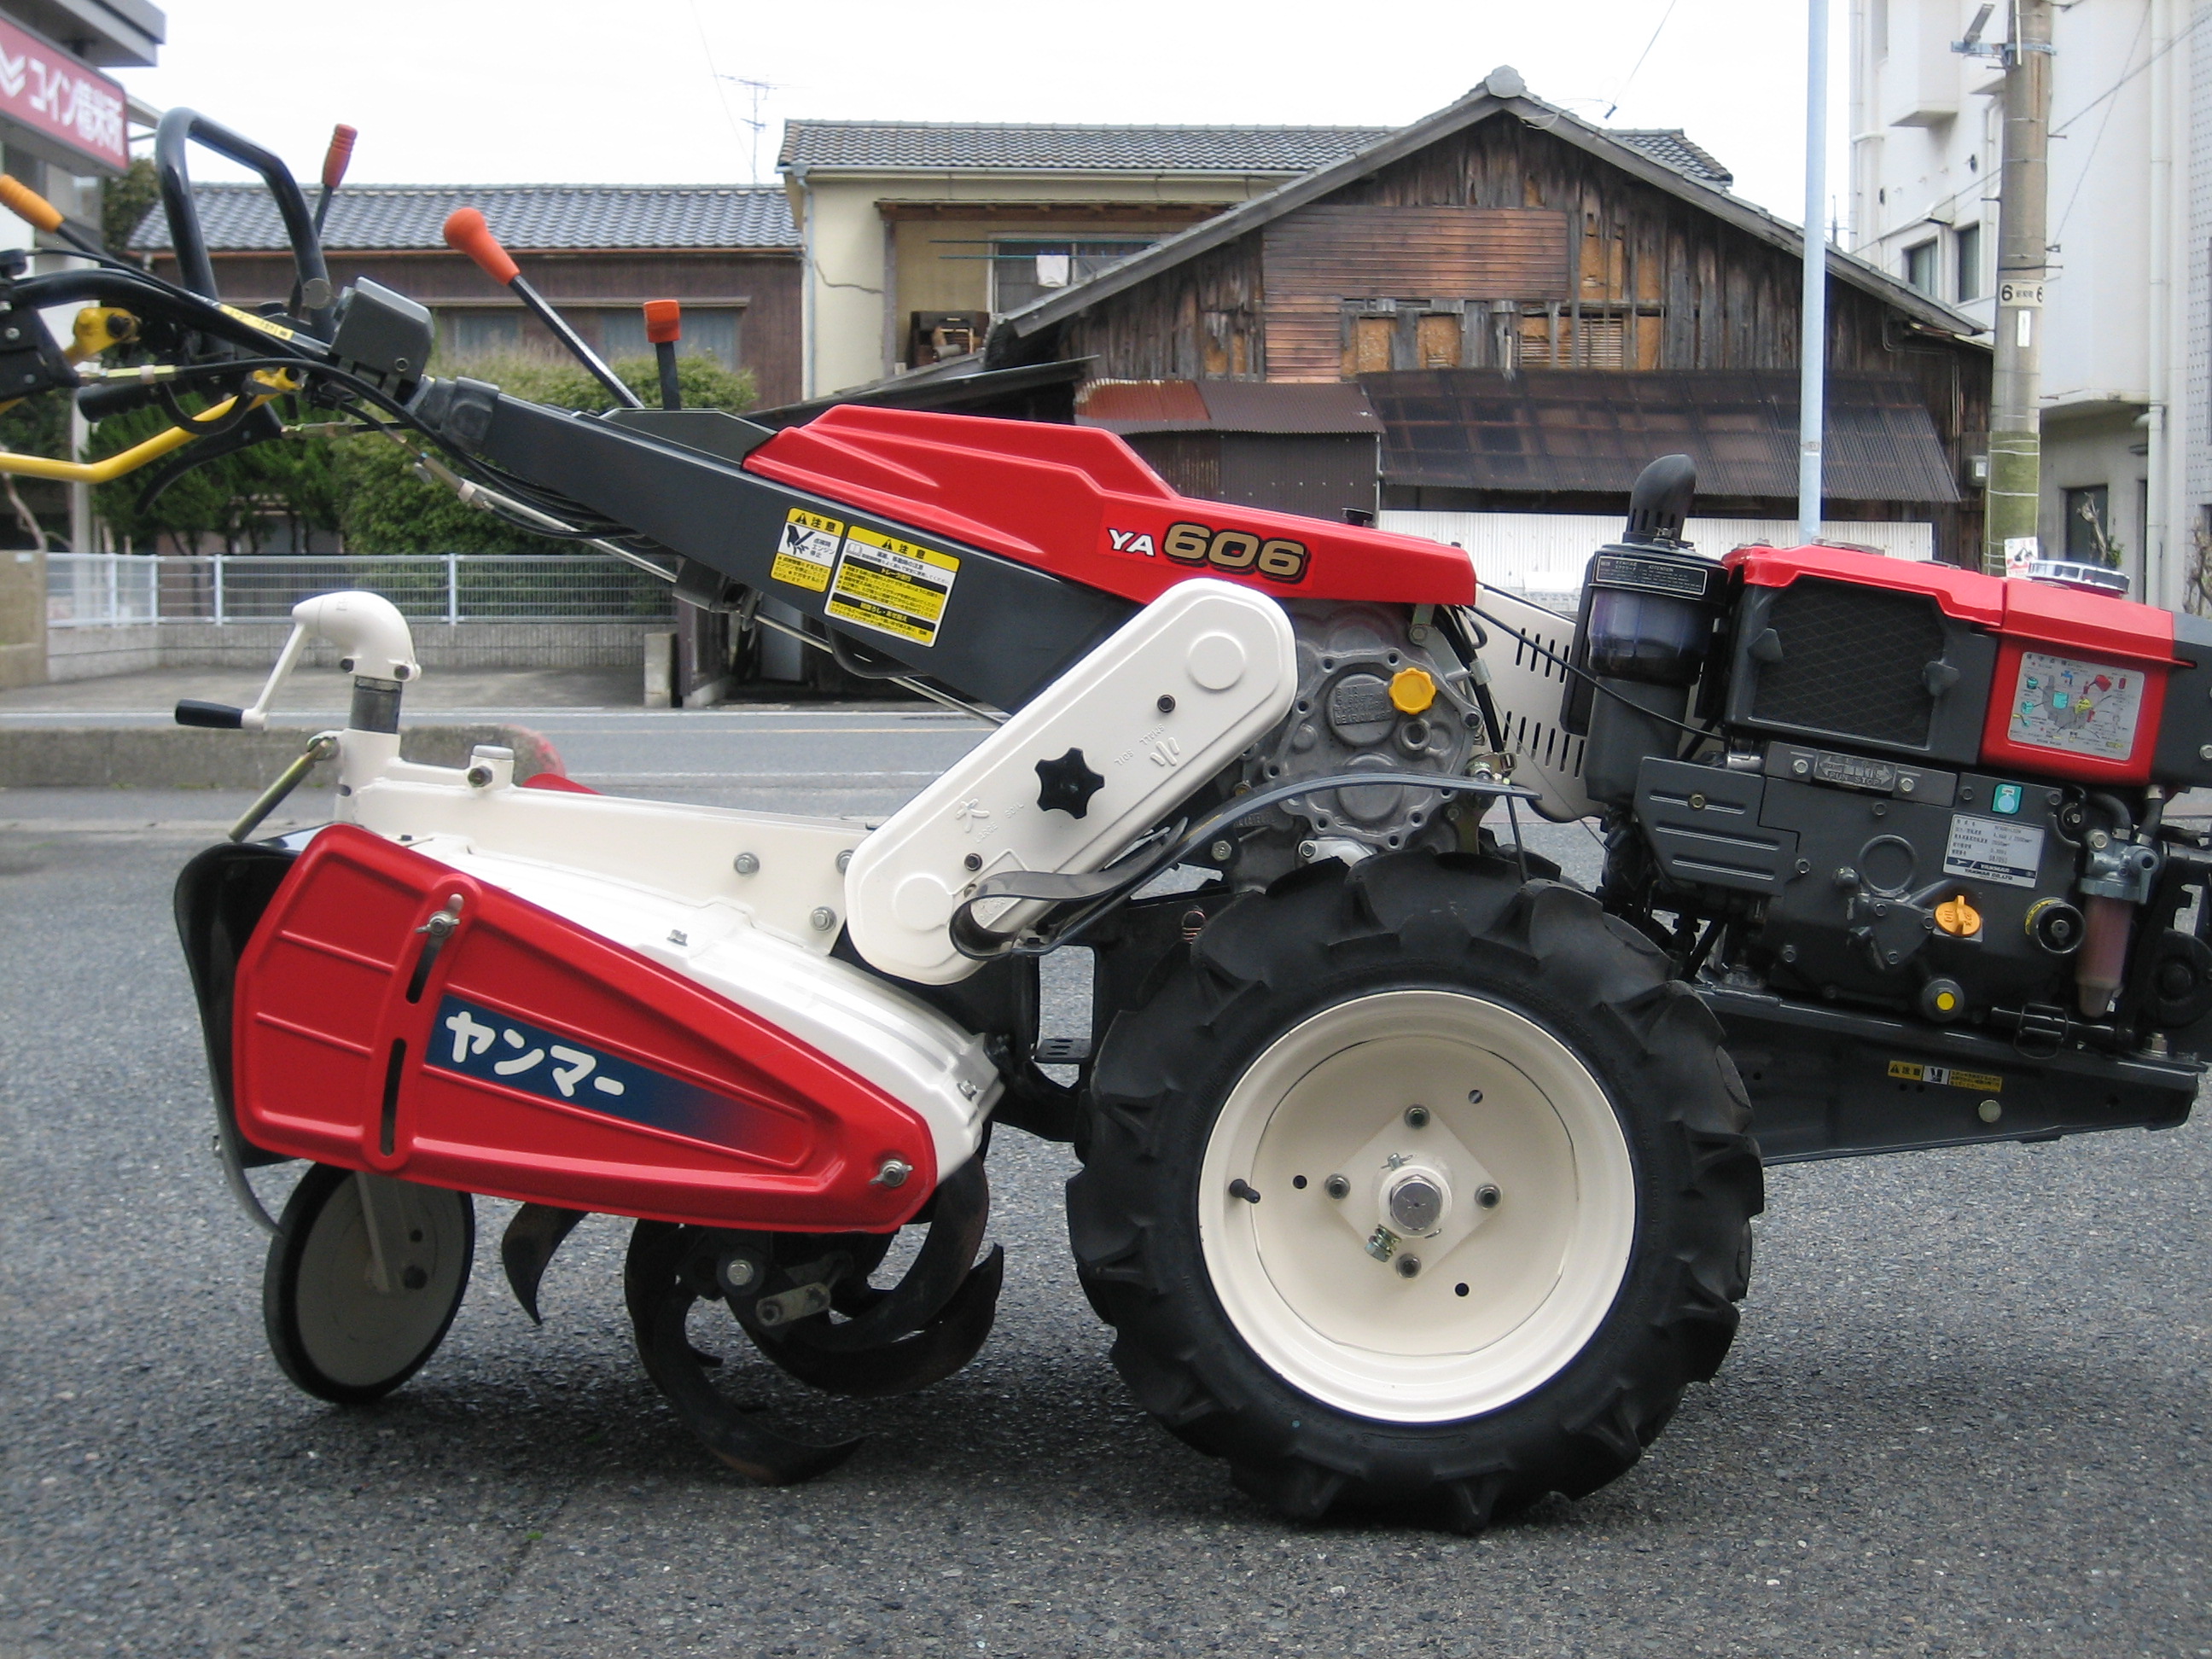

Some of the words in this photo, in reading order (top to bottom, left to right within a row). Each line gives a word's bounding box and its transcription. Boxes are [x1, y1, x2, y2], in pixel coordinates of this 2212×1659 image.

[2002, 284, 2013, 301] 6
[810, 516, 836, 533] 注意
[898, 543, 926, 560] 注意
[1108, 527, 1155, 556] YA
[1163, 521, 1309, 580] 606
[1114, 748, 1134, 766] SOIL
[1854, 774, 1881, 787] STOP
[1004, 801, 1025, 819] SOIL
[445, 1010, 626, 1097] ヤンマー
